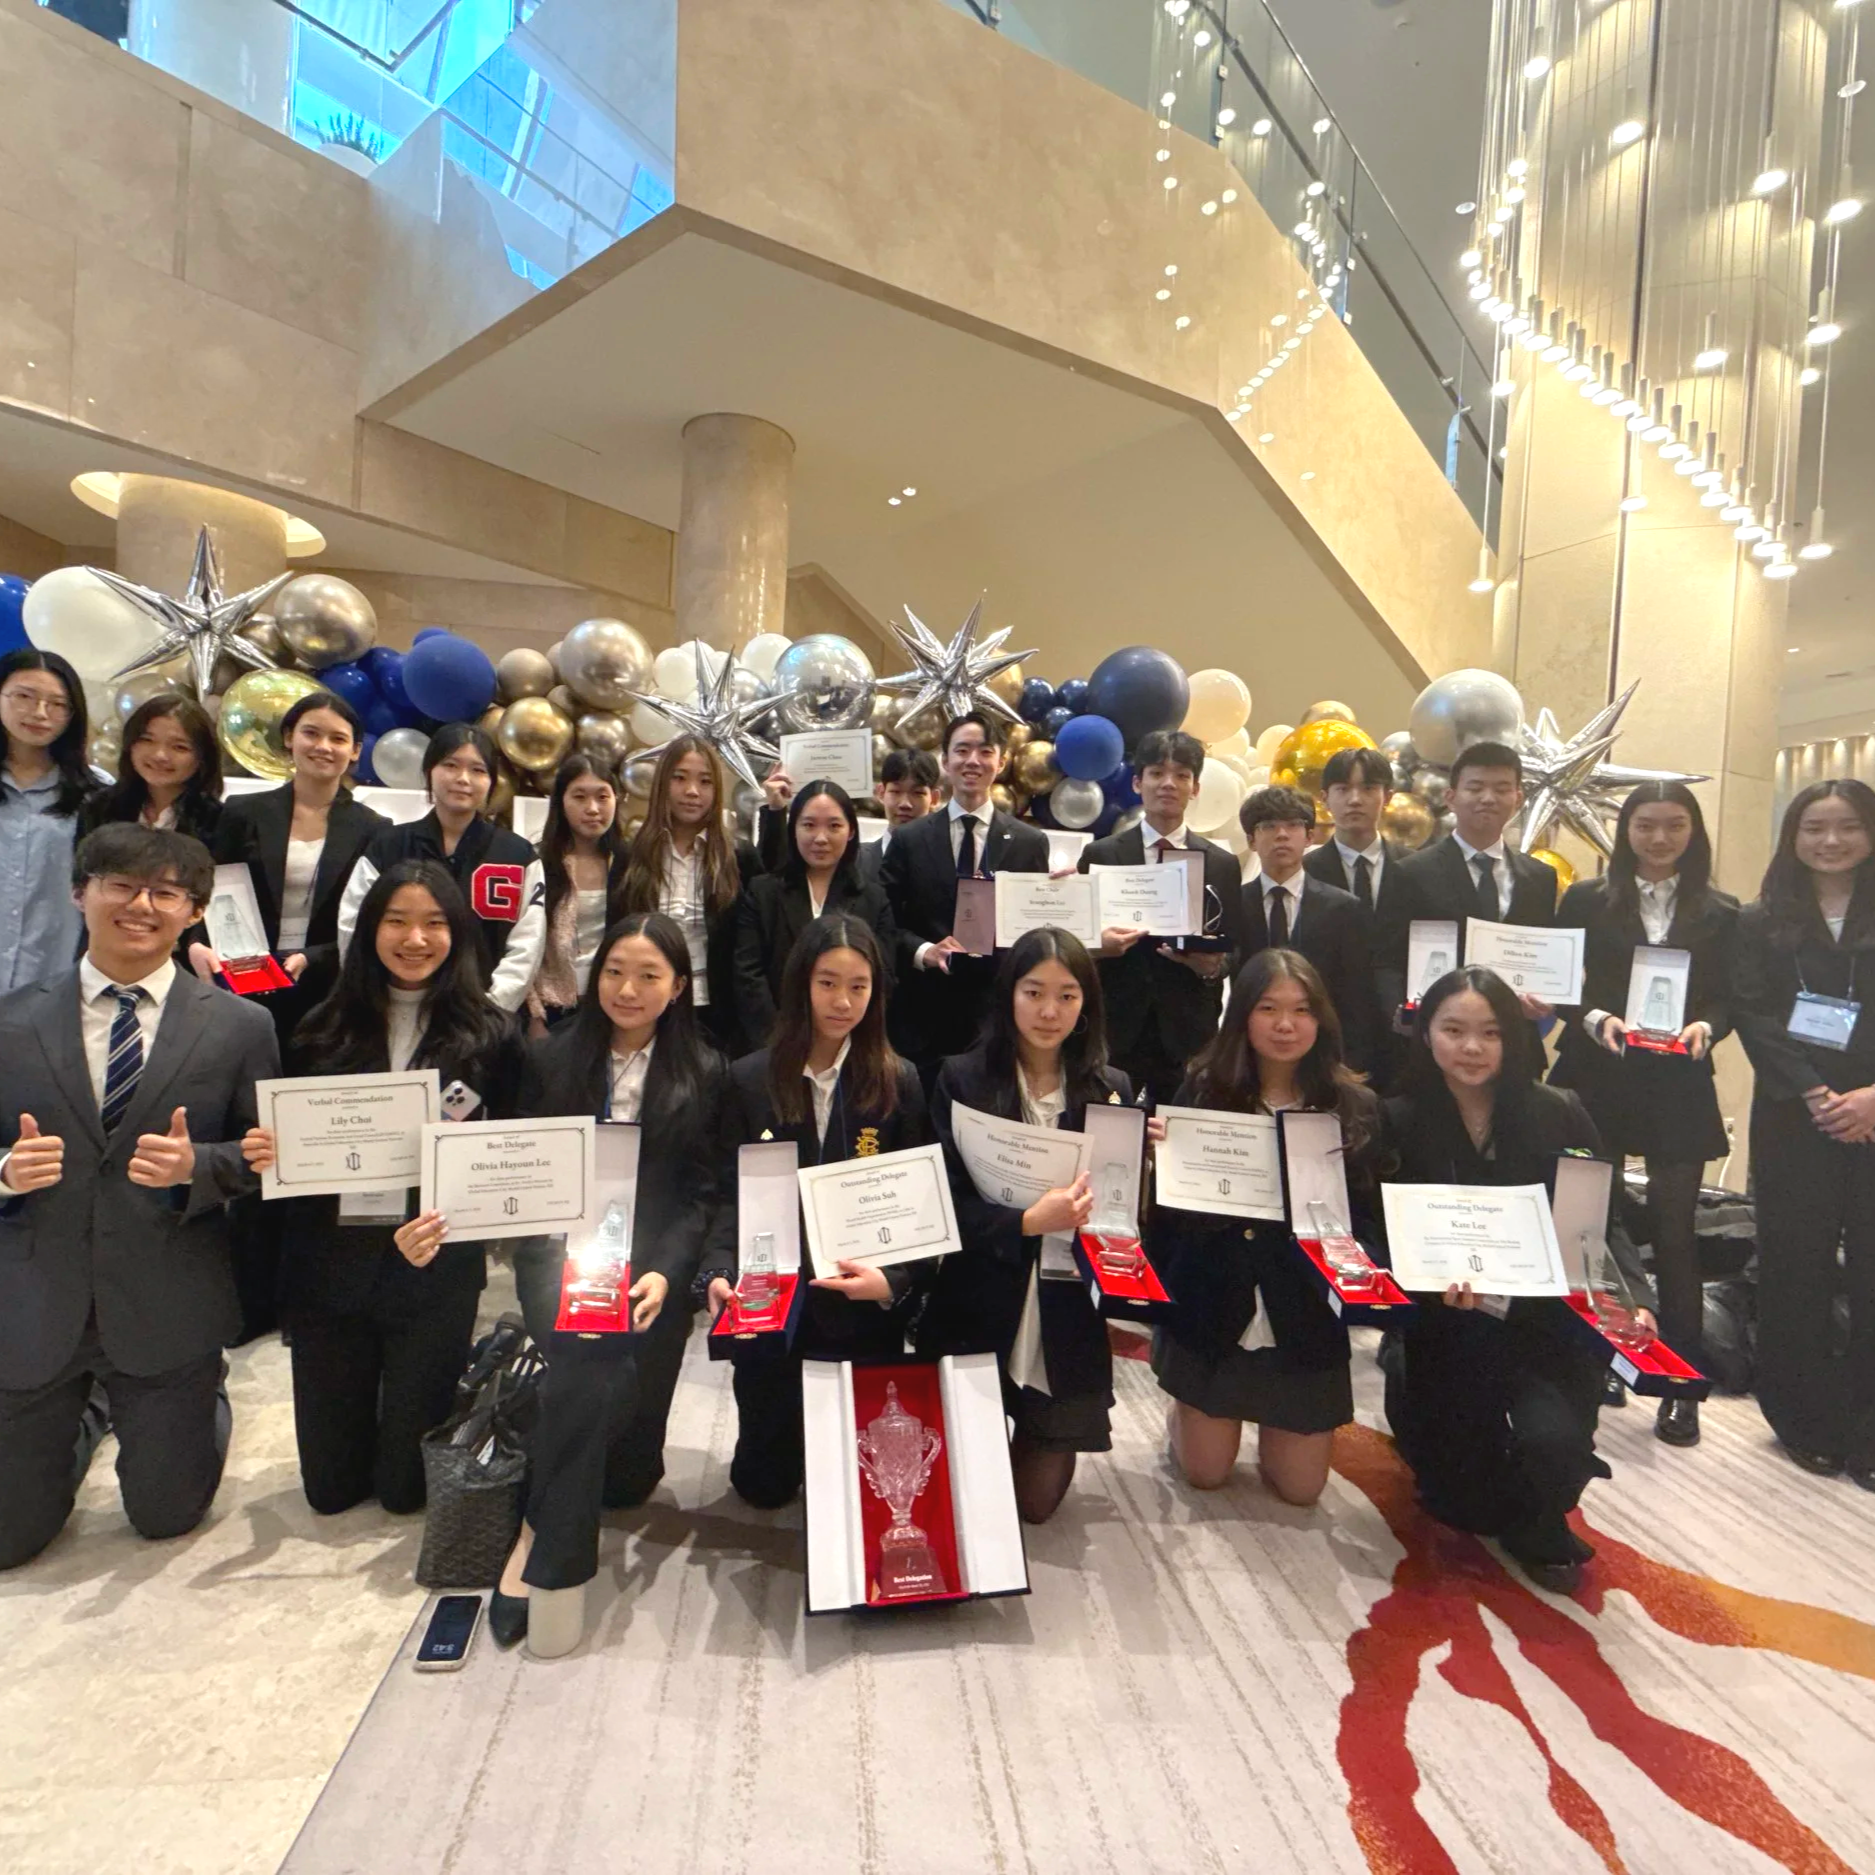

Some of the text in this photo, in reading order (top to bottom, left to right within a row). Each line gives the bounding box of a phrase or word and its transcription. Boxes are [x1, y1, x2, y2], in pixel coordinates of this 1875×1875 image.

[471, 863, 525, 922] G
[307, 1095, 394, 1107] Verbal Commendation
[331, 1115, 372, 1127] Lily Choi
[487, 1140, 536, 1150] Best Delegate
[1203, 1145, 1249, 1157] Hannah Kim
[471, 1162, 498, 1171] Olivia
[500, 1160, 534, 1172] Hayoun
[1015, 1159, 1032, 1169] Min
[840, 1176, 881, 1188] Outstanding
[881, 1171, 908, 1181] Delegate
[858, 1190, 897, 1204] Olivia Suh
[1427, 1203, 1504, 1213] Outstanding Delegate
[1451, 1220, 1470, 1230] Kate
